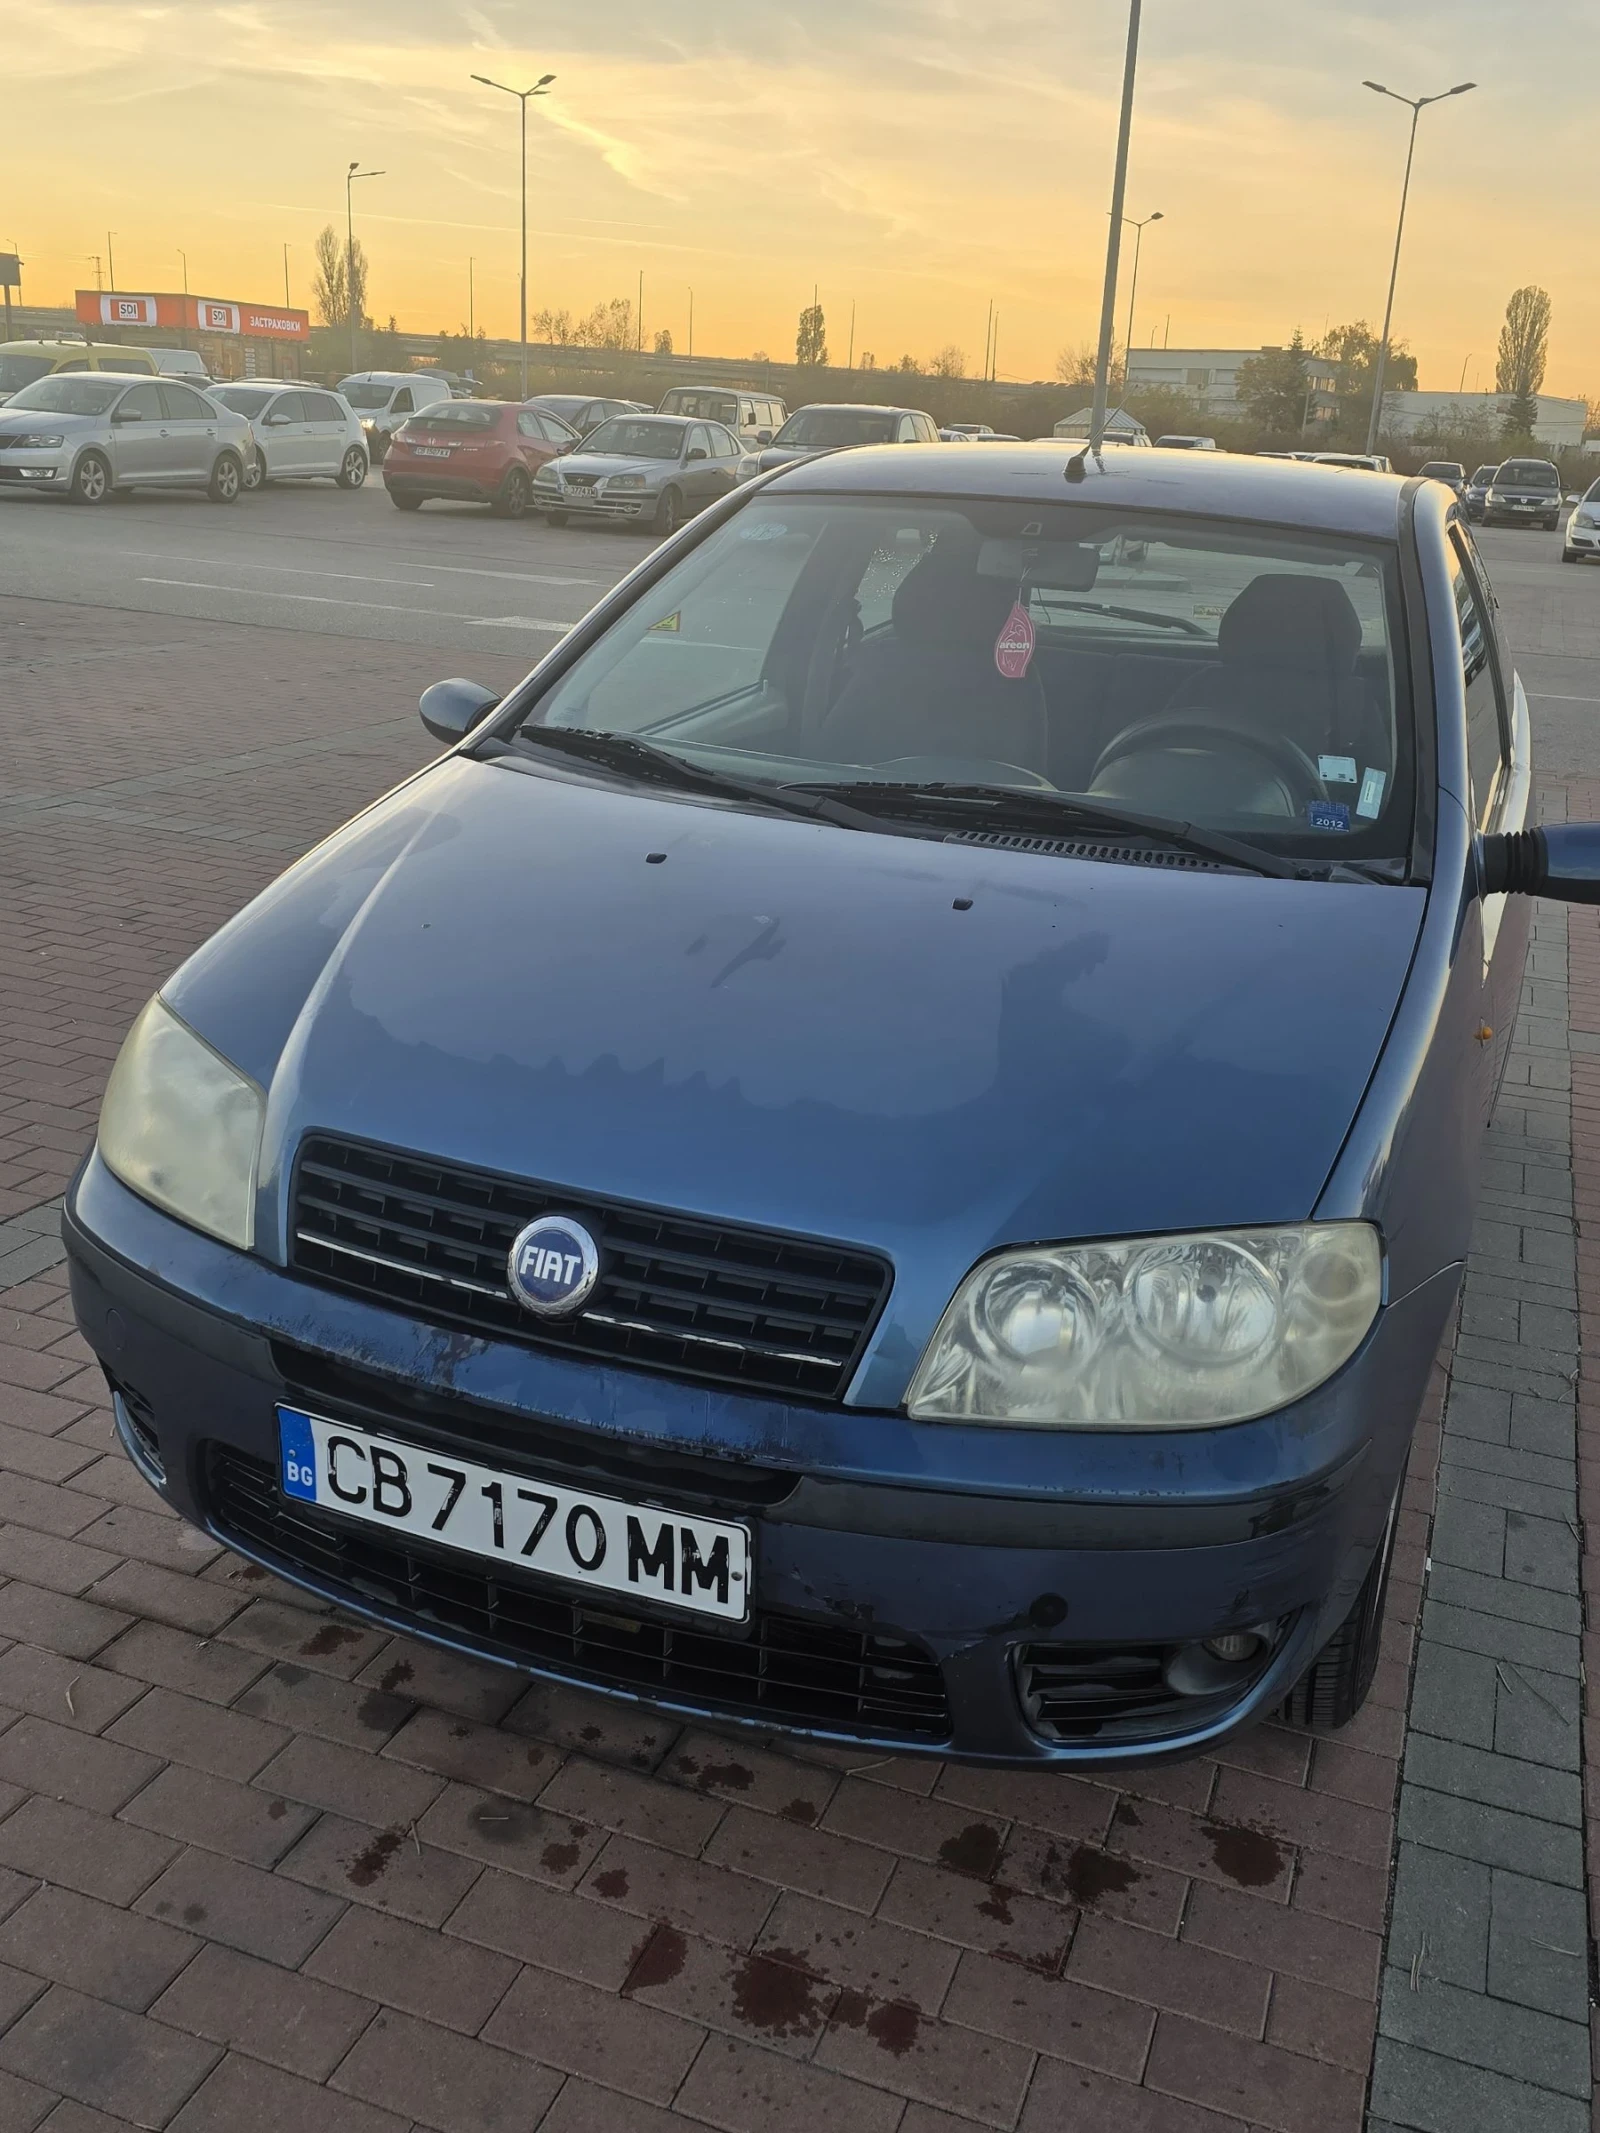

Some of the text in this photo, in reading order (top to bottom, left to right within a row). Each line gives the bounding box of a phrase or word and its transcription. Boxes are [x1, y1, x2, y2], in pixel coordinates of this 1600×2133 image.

[120, 304, 137, 315] SDI
[213, 310, 226, 321] SDI
[249, 316, 301, 332] ЗАСТРАХОВКИ
[1316, 818, 1344, 828] 2012
[519, 1245, 582, 1285] FIAT
[286, 1460, 314, 1488] BG
[327, 1435, 730, 1605] CB 7170 MM
